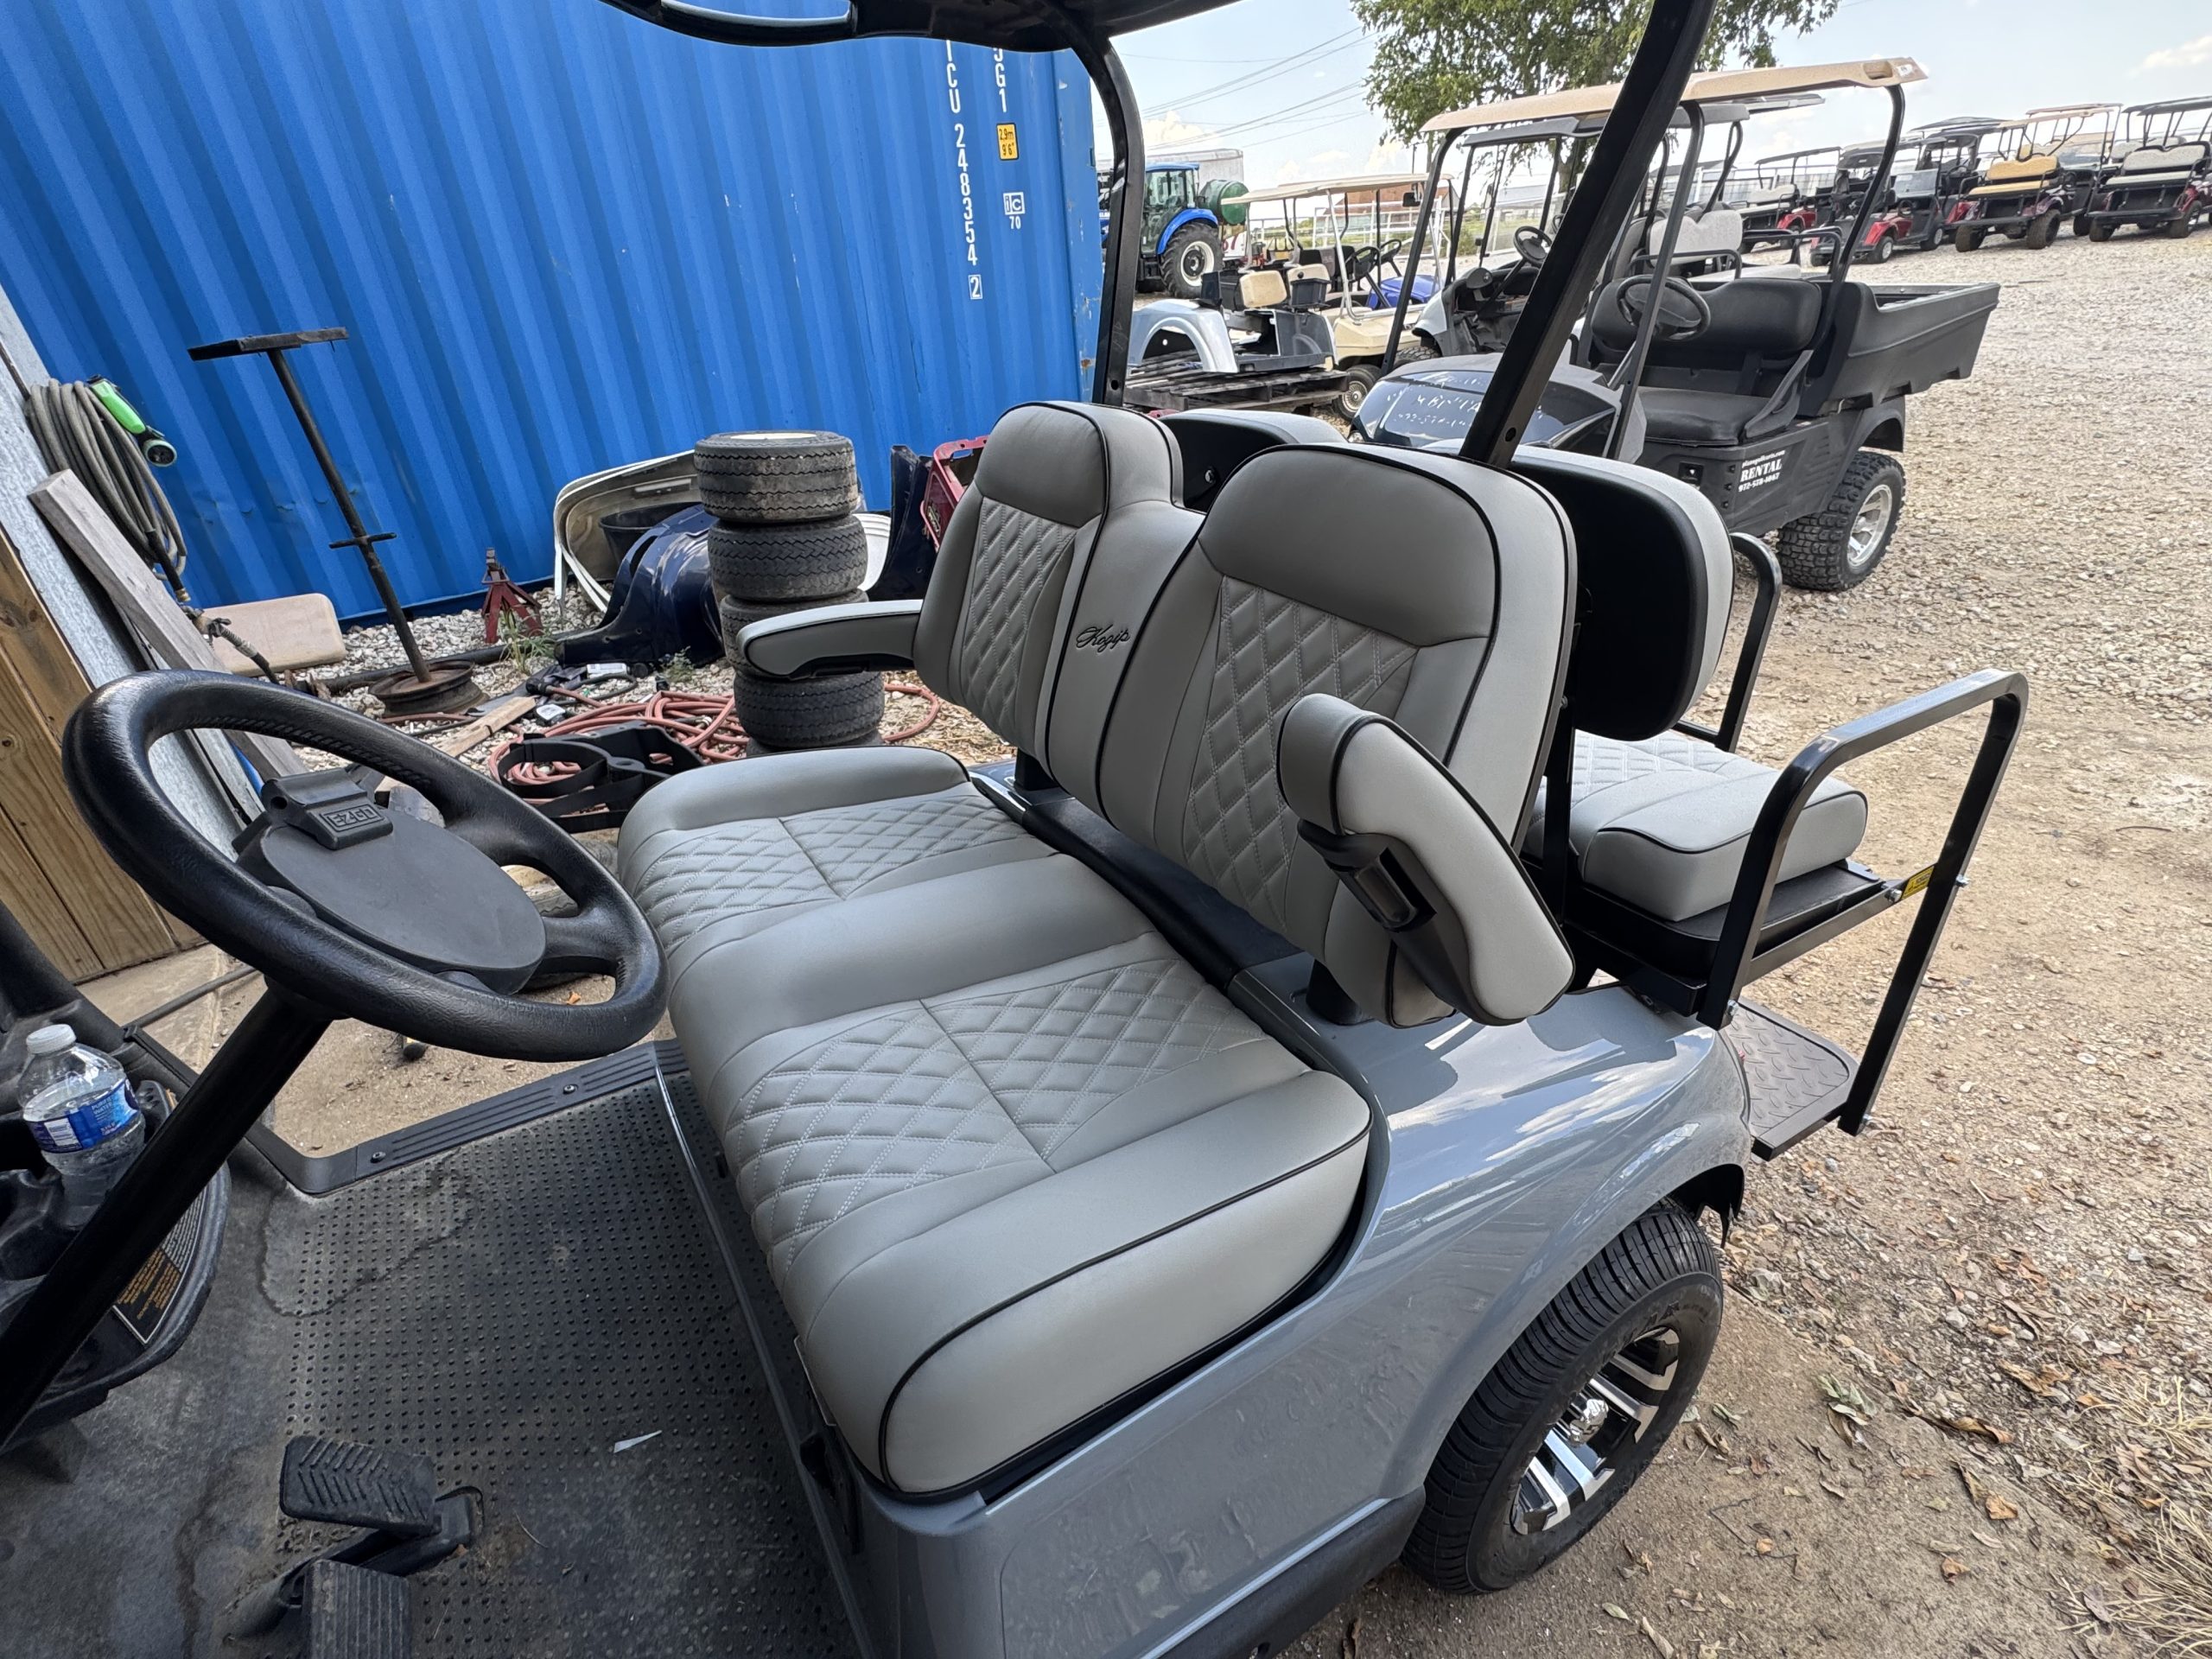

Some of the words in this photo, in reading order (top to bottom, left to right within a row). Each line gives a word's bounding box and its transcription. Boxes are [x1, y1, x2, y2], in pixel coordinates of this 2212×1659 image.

[954, 123, 978, 266] 248354
[969, 276, 981, 298] 2
[1008, 216, 1021, 230] 70
[1740, 459, 1782, 482] RENTAL
